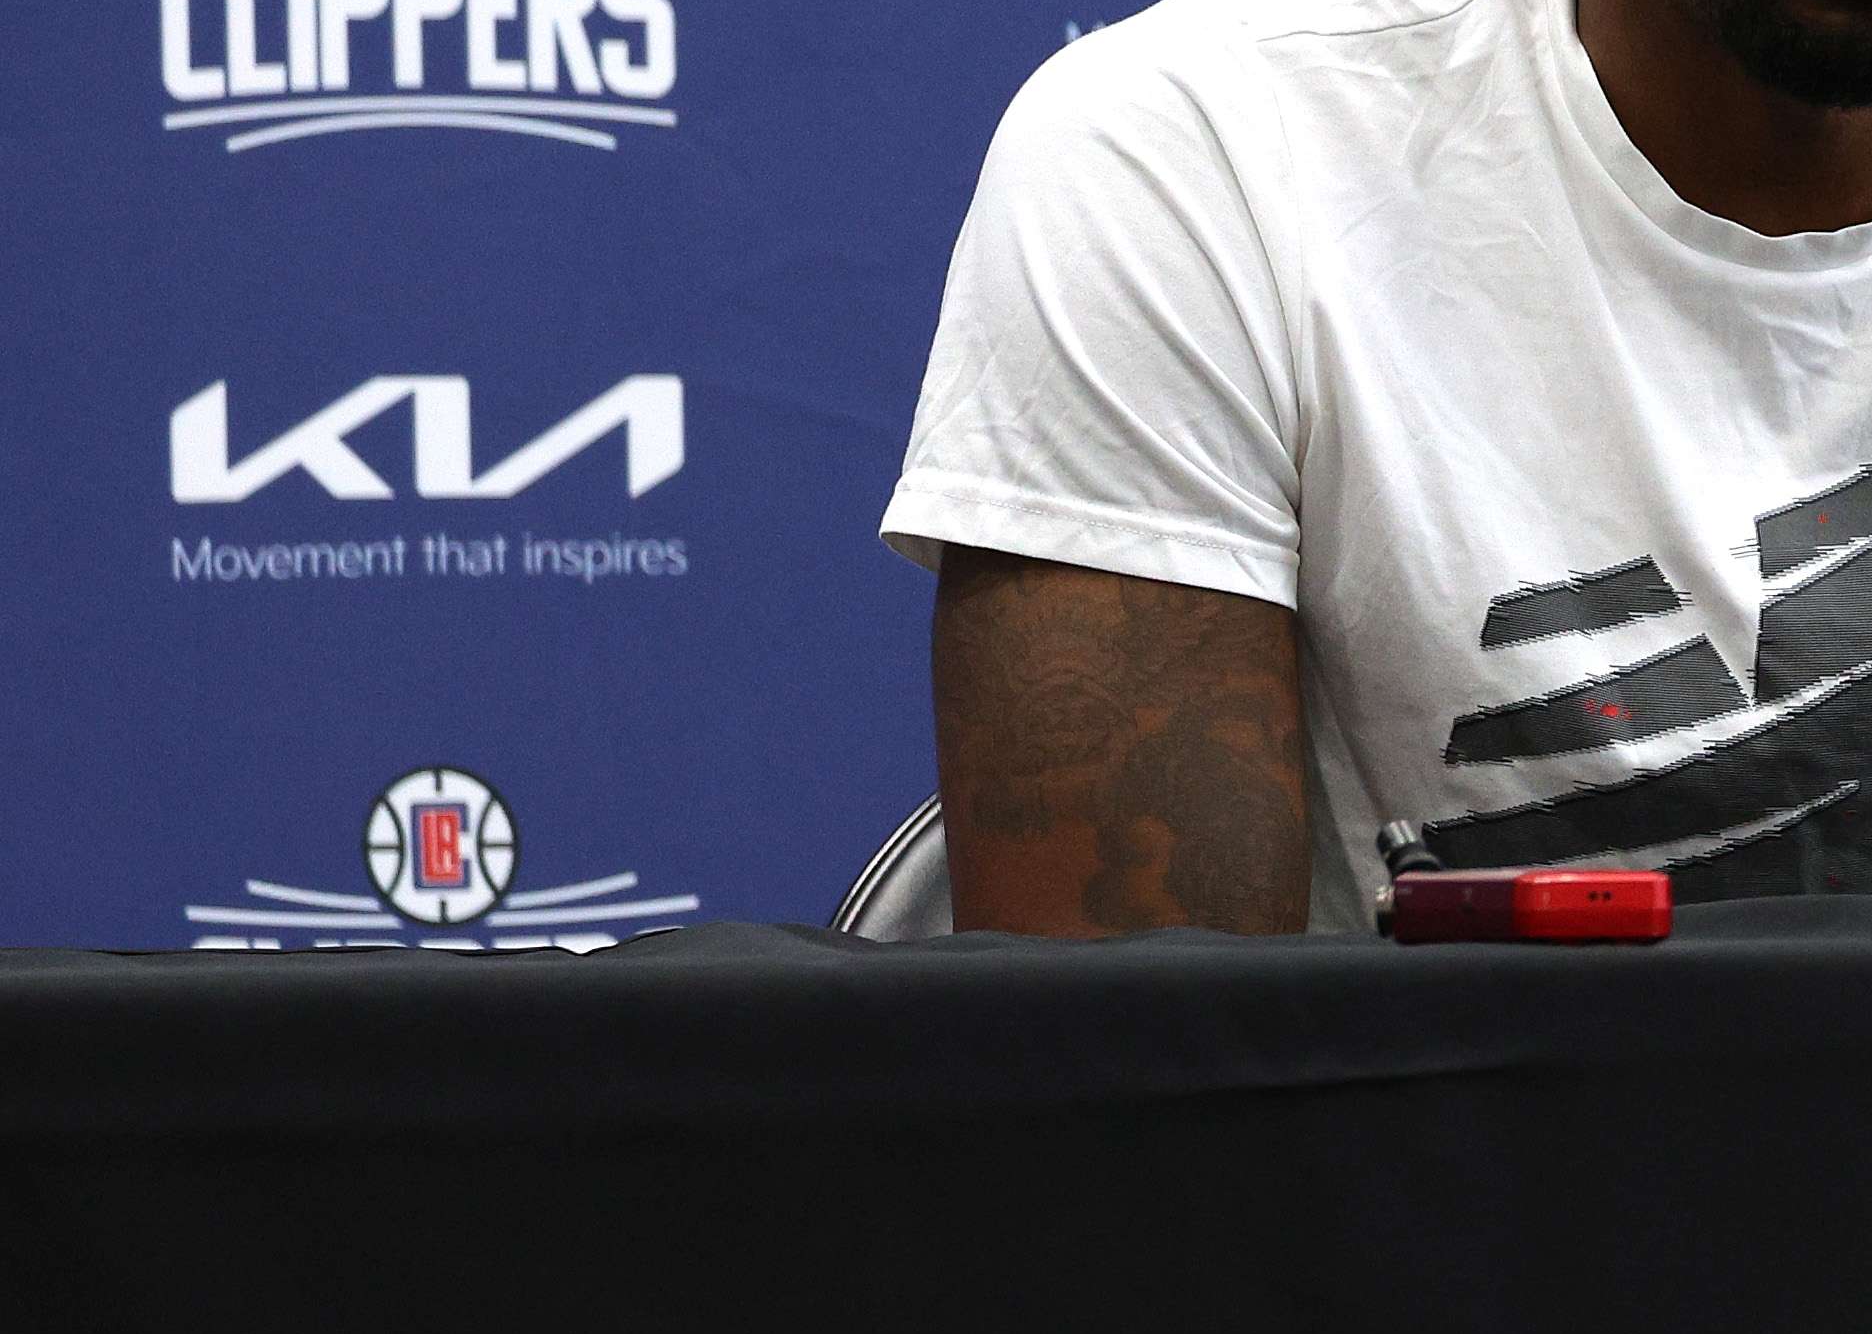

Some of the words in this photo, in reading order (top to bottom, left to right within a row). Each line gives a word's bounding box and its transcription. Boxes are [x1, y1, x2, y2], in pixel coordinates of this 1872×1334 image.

[170, 375, 685, 503] KIA
[171, 536, 407, 580] Movement
[421, 532, 508, 576] that
[522, 532, 688, 584] inspires
